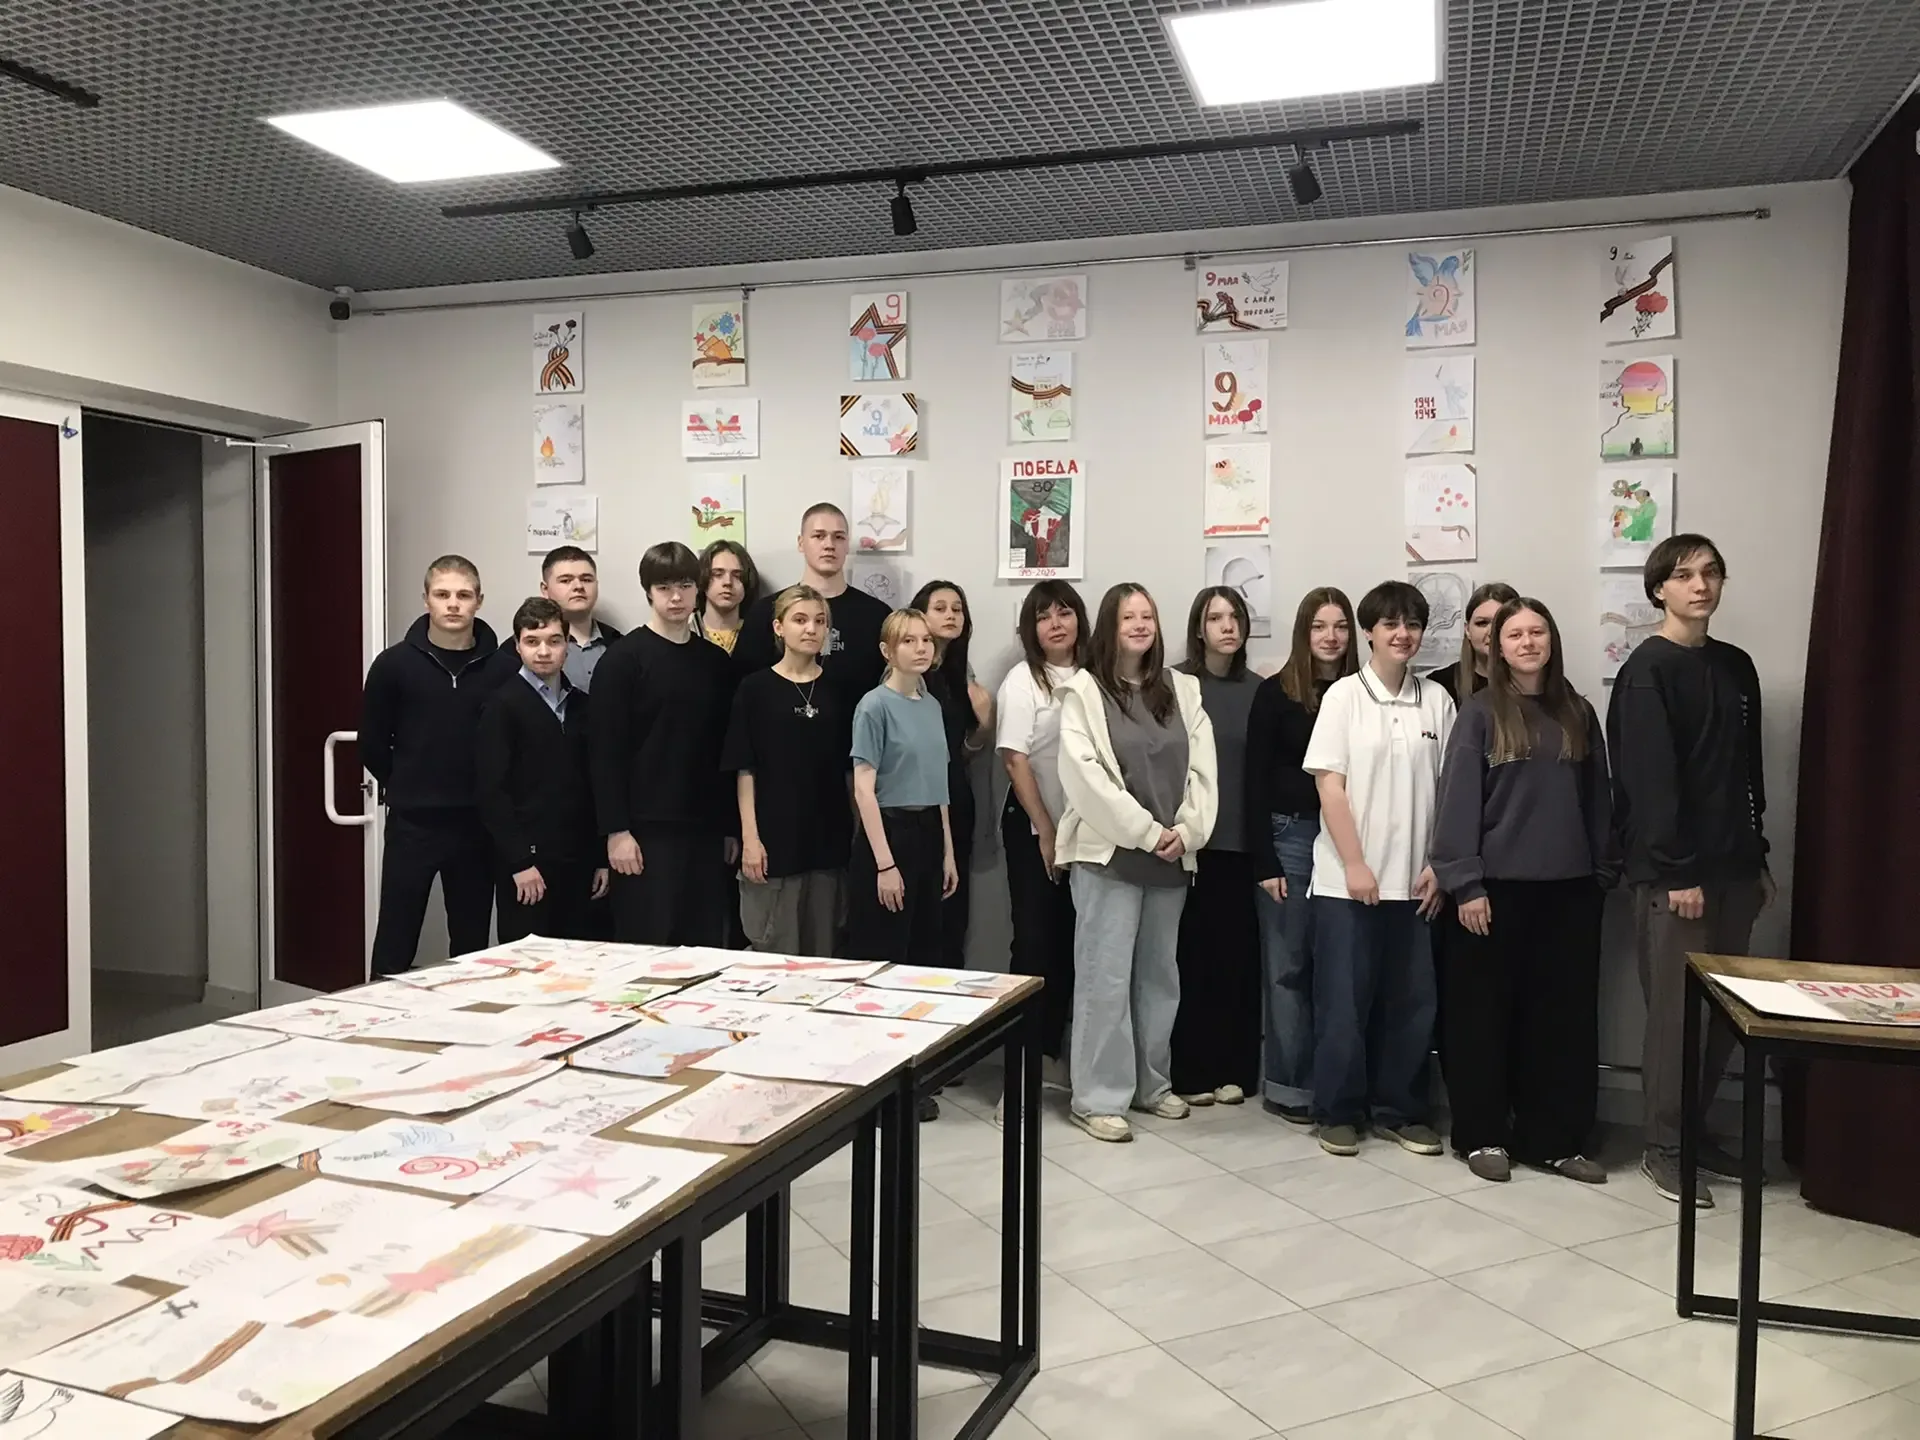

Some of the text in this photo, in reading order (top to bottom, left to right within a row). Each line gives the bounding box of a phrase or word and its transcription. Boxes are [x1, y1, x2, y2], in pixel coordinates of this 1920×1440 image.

[1205, 271, 1217, 287] 9
[885, 294, 901, 320] 9
[1211, 371, 1238, 412] 9
[1414, 396, 1435, 408] 1941
[1414, 408, 1437, 420] 1945
[1014, 459, 1079, 477] ПОБЕДА
[1032, 480, 1054, 493] 80
[1422, 730, 1438, 740] FILA
[1797, 982, 1914, 999] 9 МАЯ
[398, 1155, 480, 1181] 9
[80, 1212, 193, 1260] МАЯ
